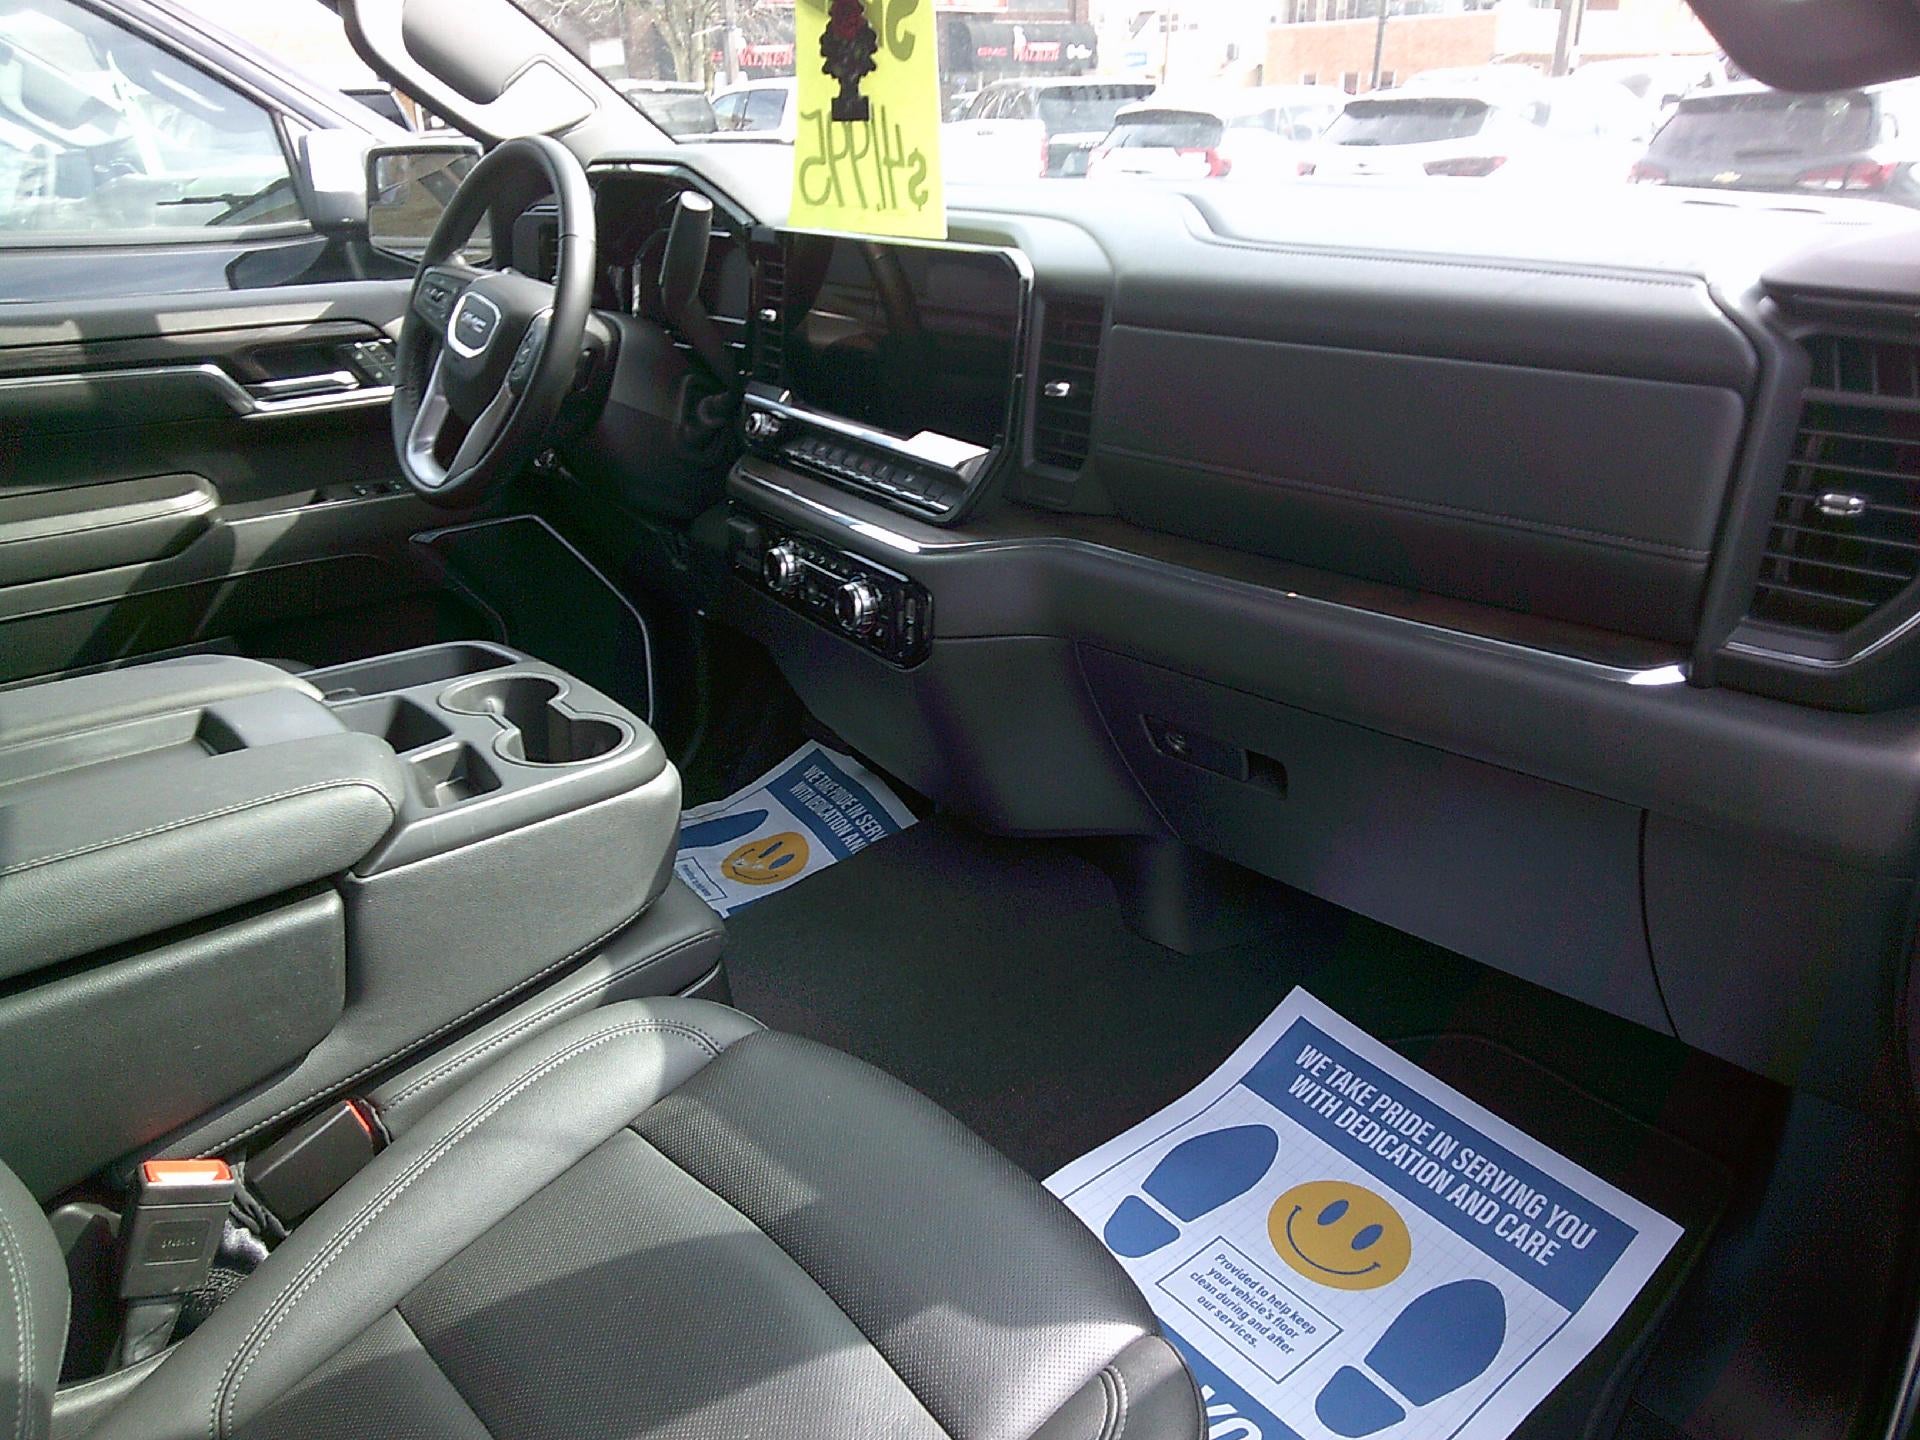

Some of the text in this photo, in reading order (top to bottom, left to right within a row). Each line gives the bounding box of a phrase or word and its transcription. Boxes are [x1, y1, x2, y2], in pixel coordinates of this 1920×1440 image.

[789, 780, 816, 802] WITH
[802, 764, 824, 782] WE
[845, 801, 867, 819] IN
[1288, 1074, 1562, 1266] WITH DEDICATION AND CARE
[1296, 1044, 1598, 1249] WE TAKE PRIDE IN SERVING YOU
[1190, 1272, 1295, 1354] clean during and after
[1197, 1296, 1258, 1348] our services.
[1206, 1267, 1300, 1339] your vehicle's floor
[1214, 1253, 1317, 1335] Provided to help keep
